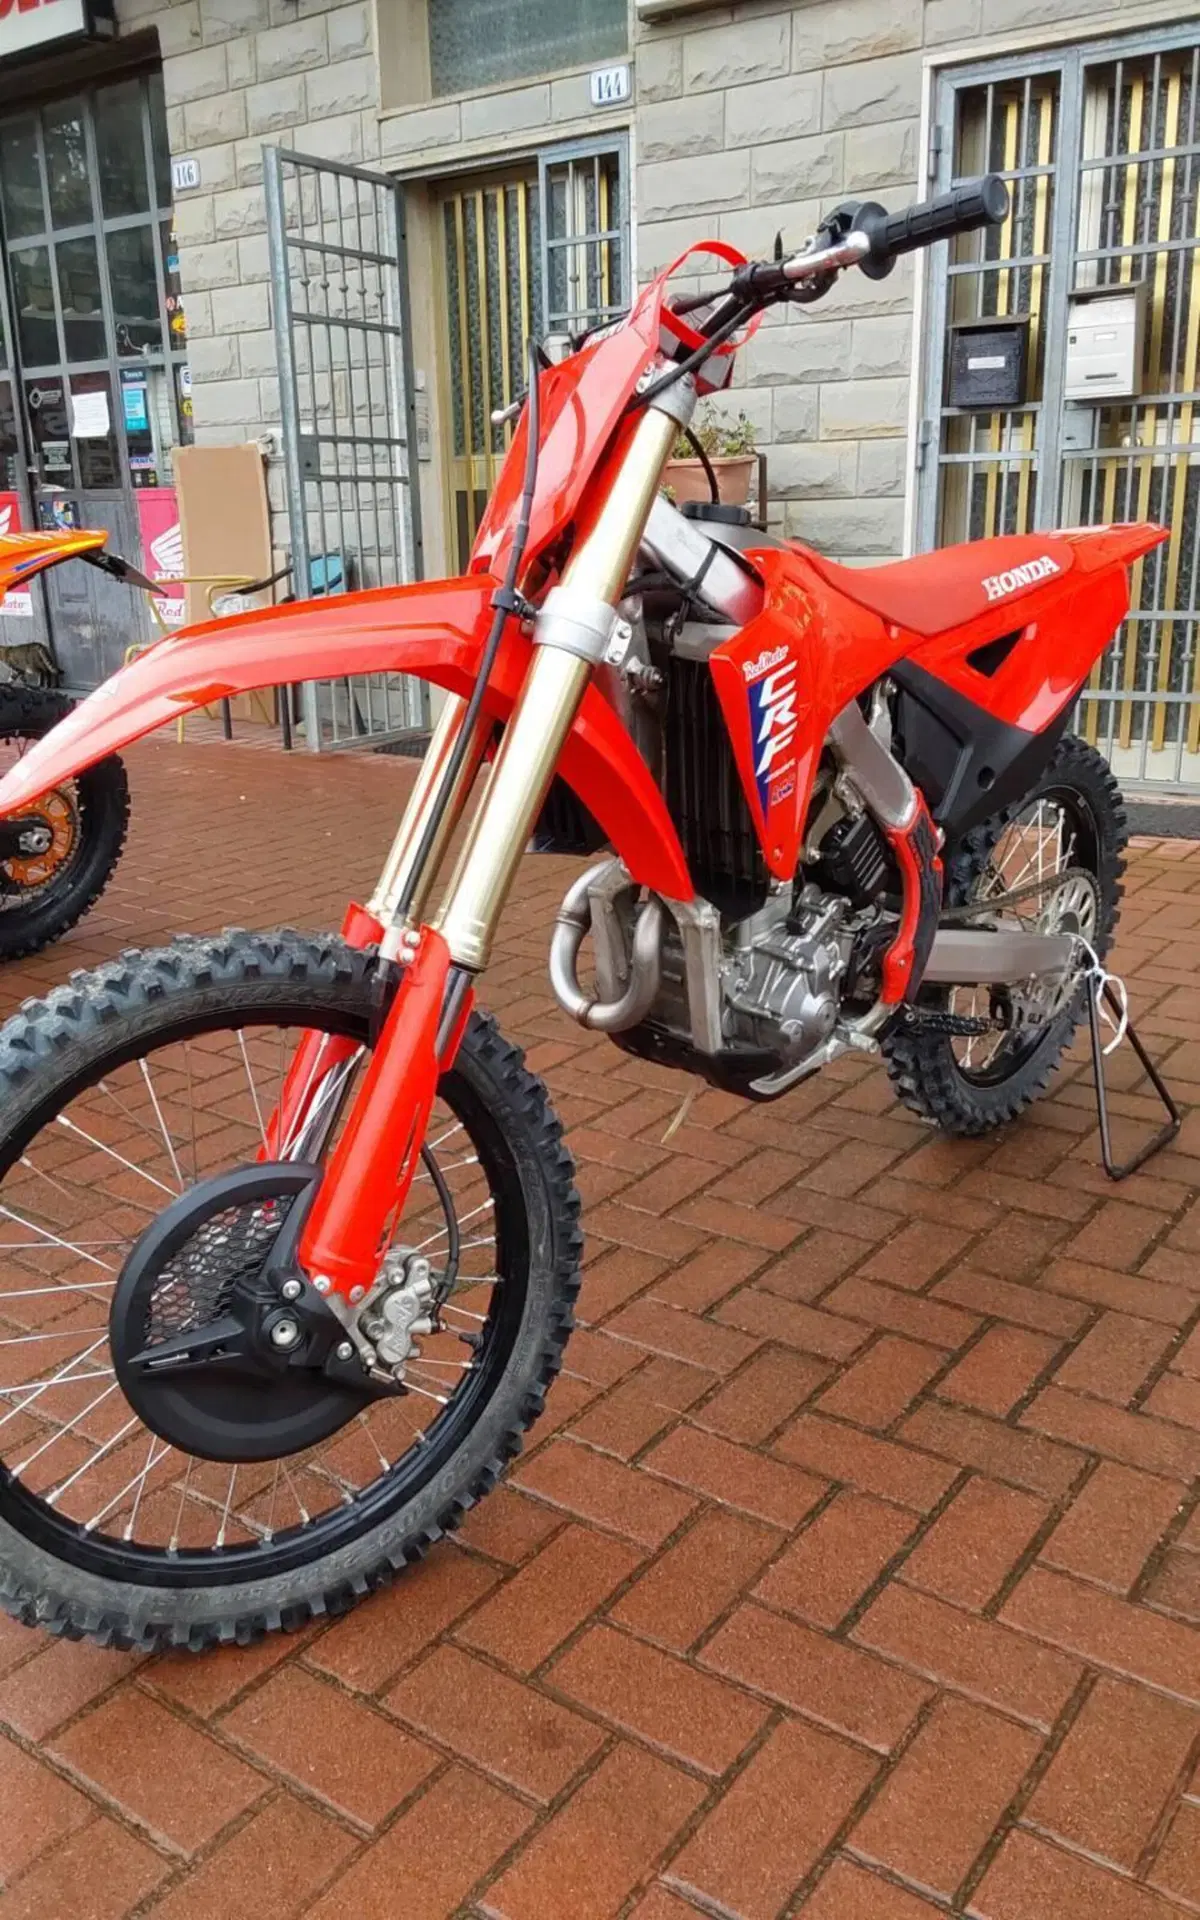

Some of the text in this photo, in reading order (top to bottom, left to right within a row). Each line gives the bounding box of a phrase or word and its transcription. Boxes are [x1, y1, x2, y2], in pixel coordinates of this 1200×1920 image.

[597, 71, 621, 100] 144
[176, 164, 195, 186] 146
[980, 555, 1060, 601] HONDA
[756, 660, 798, 777] CRF
